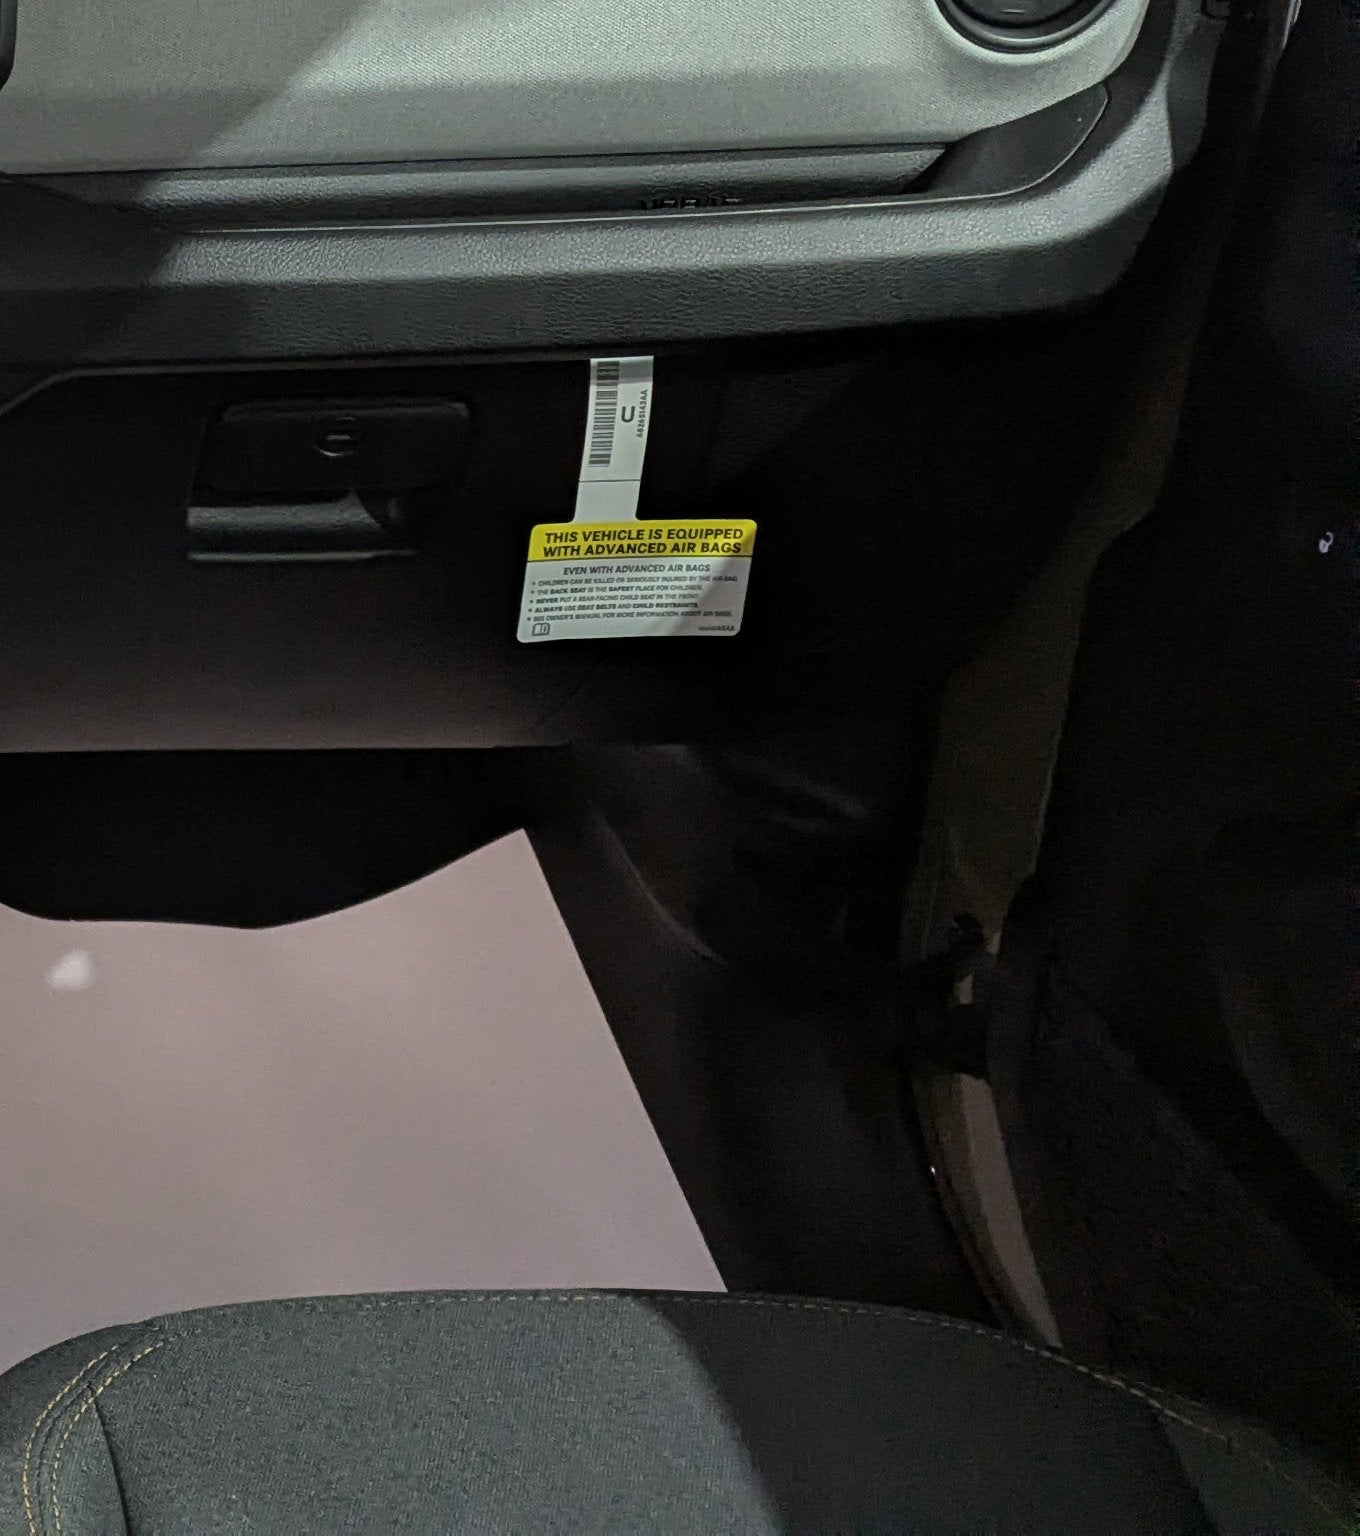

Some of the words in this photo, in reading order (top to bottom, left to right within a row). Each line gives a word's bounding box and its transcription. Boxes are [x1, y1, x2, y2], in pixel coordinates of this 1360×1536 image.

[545, 531, 577, 543] THIS
[581, 530, 646, 543] VEHICLE
[648, 529, 663, 540] IS
[666, 528, 743, 540] EQUIPPED
[543, 545, 581, 557] WITH
[584, 543, 667, 556] ADVANCED
[670, 543, 698, 553] AIR
[701, 542, 742, 554] BAGS
[563, 566, 587, 575] EVEN
[589, 565, 613, 574] WITH
[615, 565, 665, 574] ADVANCED
[667, 564, 683, 572] AIR
[685, 564, 711, 572] BAGS
